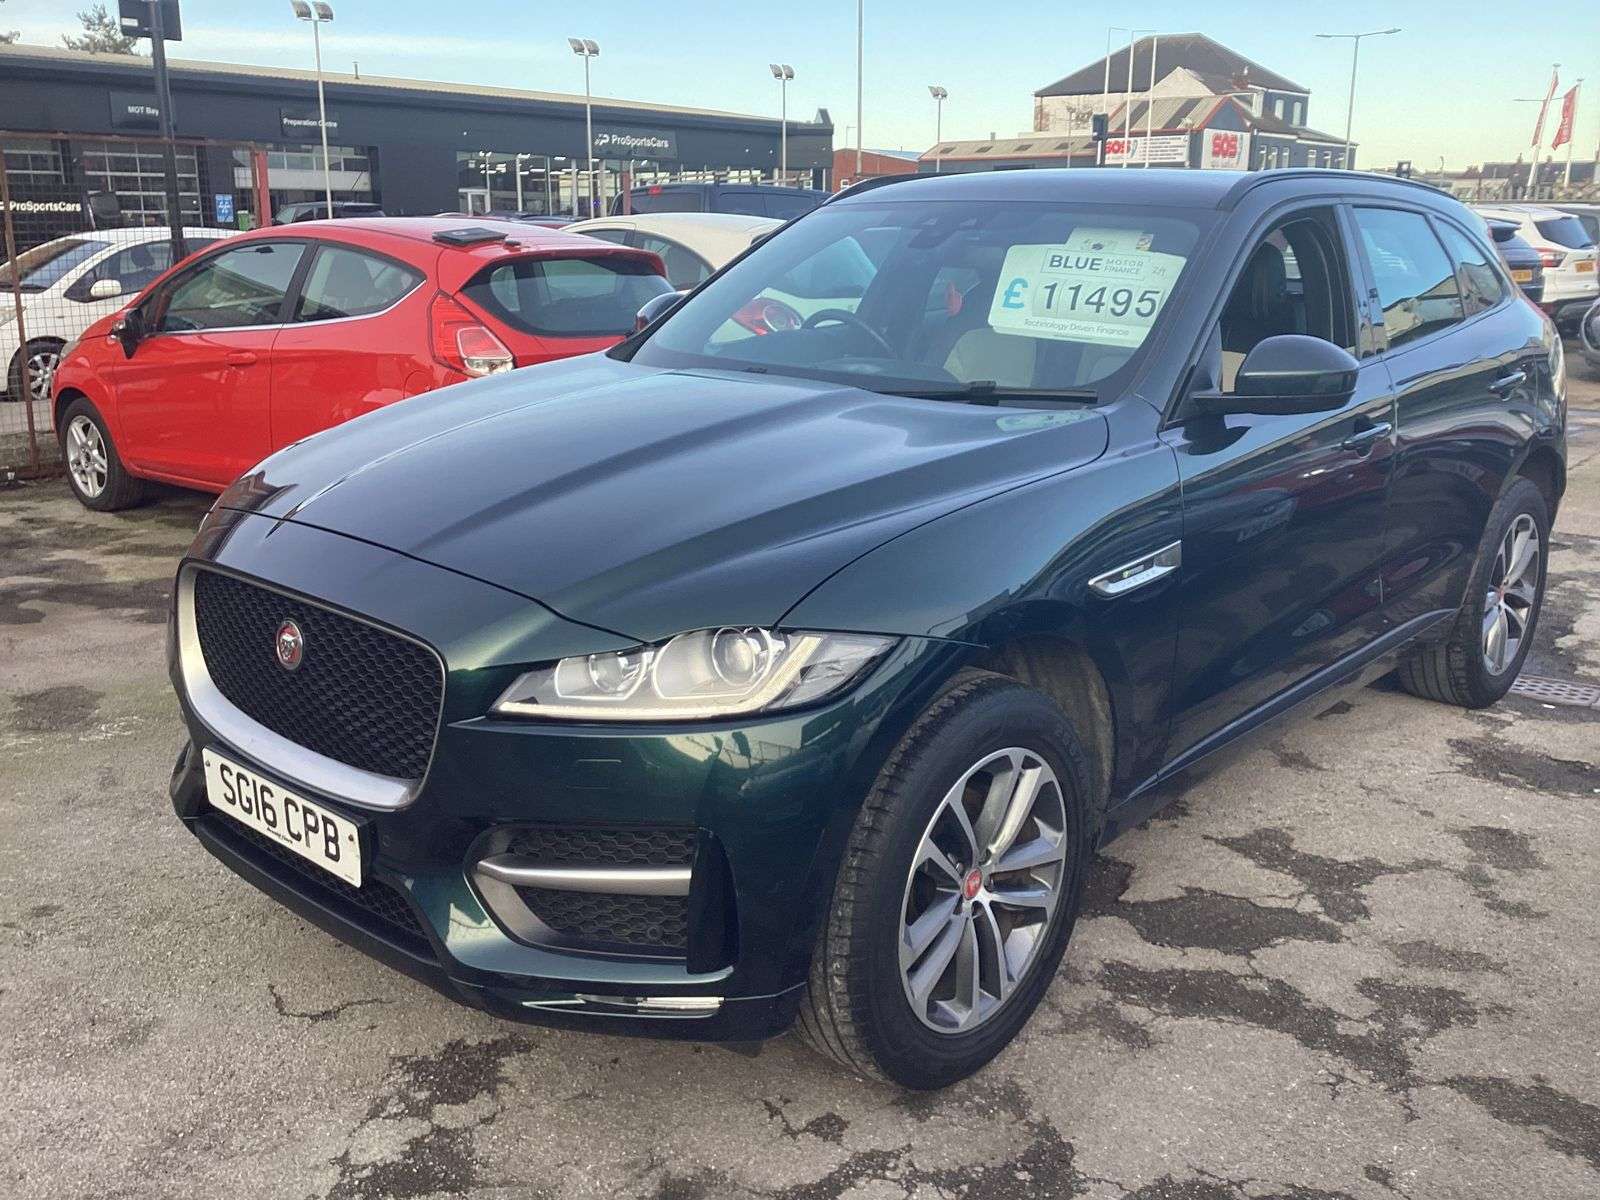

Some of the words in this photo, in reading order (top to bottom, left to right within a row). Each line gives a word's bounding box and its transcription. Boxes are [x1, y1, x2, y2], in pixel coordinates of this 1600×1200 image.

[128, 105, 144, 114] MOT
[146, 106, 159, 116] Bay
[283, 118, 317, 126] Preparation
[612, 134, 669, 149] ProSportsCars
[1105, 140, 1131, 154] SOS
[1212, 133, 1238, 158] SOS
[9, 201, 82, 213] ProSportsCars
[1049, 254, 1103, 271] BLUE
[1106, 257, 1143, 267] MOTOR
[1103, 265, 1140, 275] FINANCE
[1002, 277, 1029, 310] £
[1044, 281, 1161, 318] 11495
[1024, 318, 1069, 332] Technology
[1069, 323, 1095, 332] Driven
[220, 763, 277, 828] SG16
[284, 796, 341, 863] CPB
